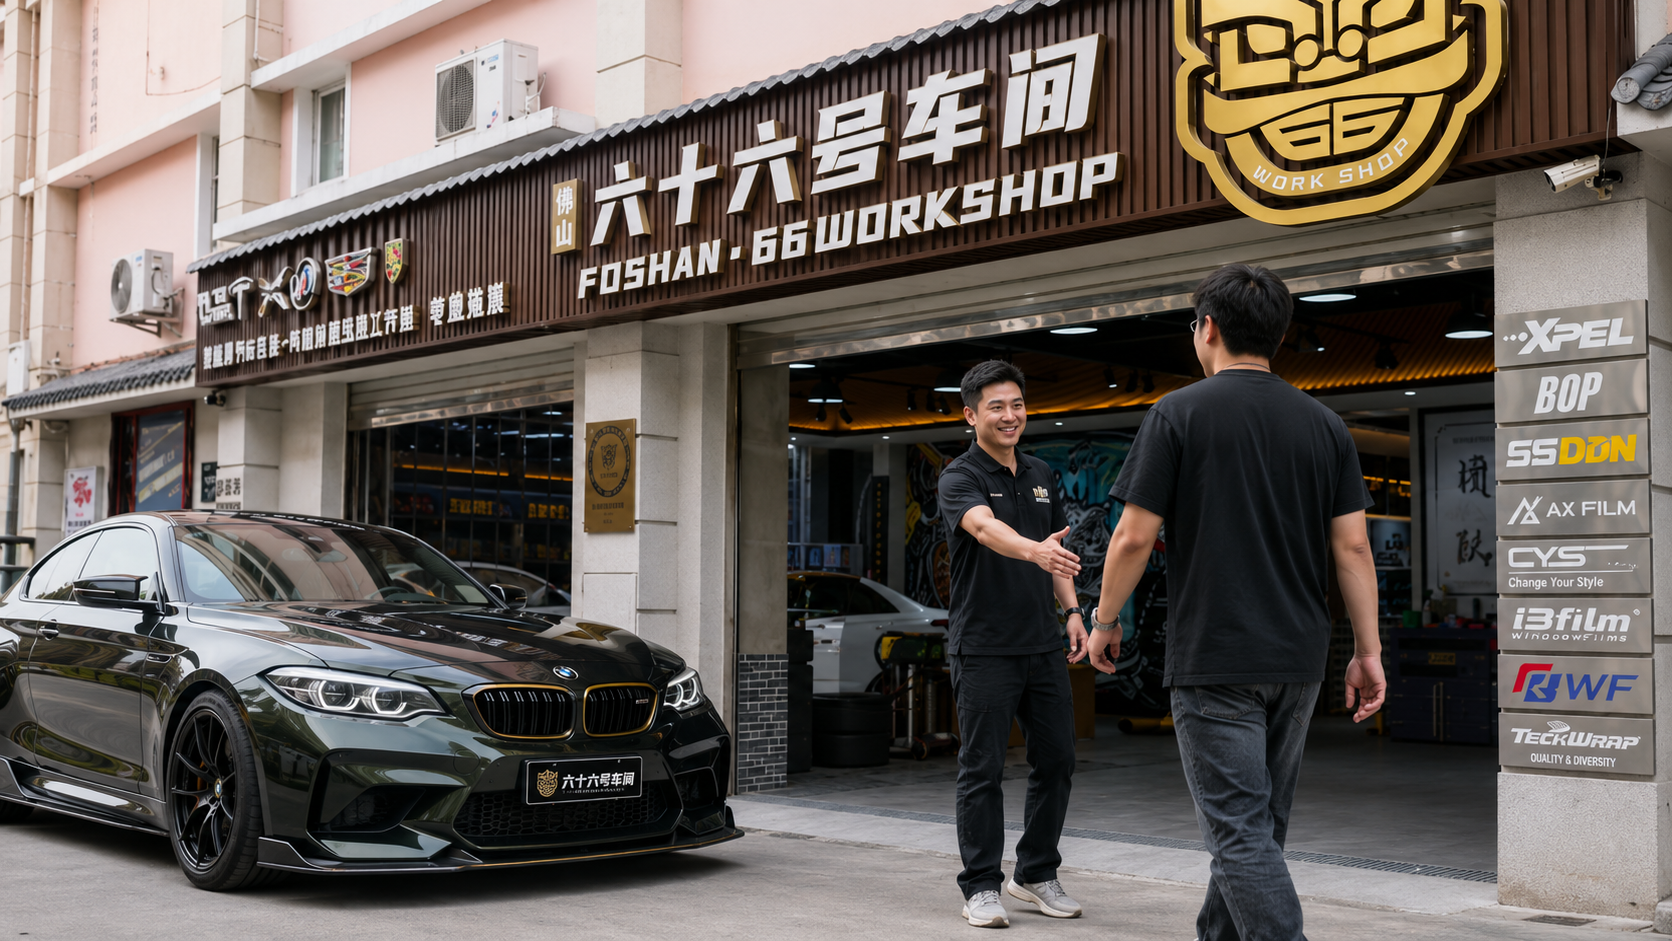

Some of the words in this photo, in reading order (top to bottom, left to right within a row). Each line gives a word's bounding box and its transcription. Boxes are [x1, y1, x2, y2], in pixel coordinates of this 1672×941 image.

[590, 33, 1104, 247] 六十六号车间
[1253, 165, 1324, 192] WORK
[1339, 137, 1408, 184] SHOP
[554, 186, 575, 247] 佛山
[1517, 317, 1634, 355] XPEL
[1533, 371, 1603, 415] BOP
[1546, 502, 1575, 518] AX
[1581, 500, 1636, 517] FILM
[1508, 545, 1600, 567] CYS
[1508, 576, 1547, 590] Change
[1550, 576, 1574, 588] Your
[1577, 576, 1604, 590] Style
[1530, 752, 1563, 765] QUALITY
[1565, 755, 1572, 765] &
[1573, 755, 1616, 768] DIVERSITY
